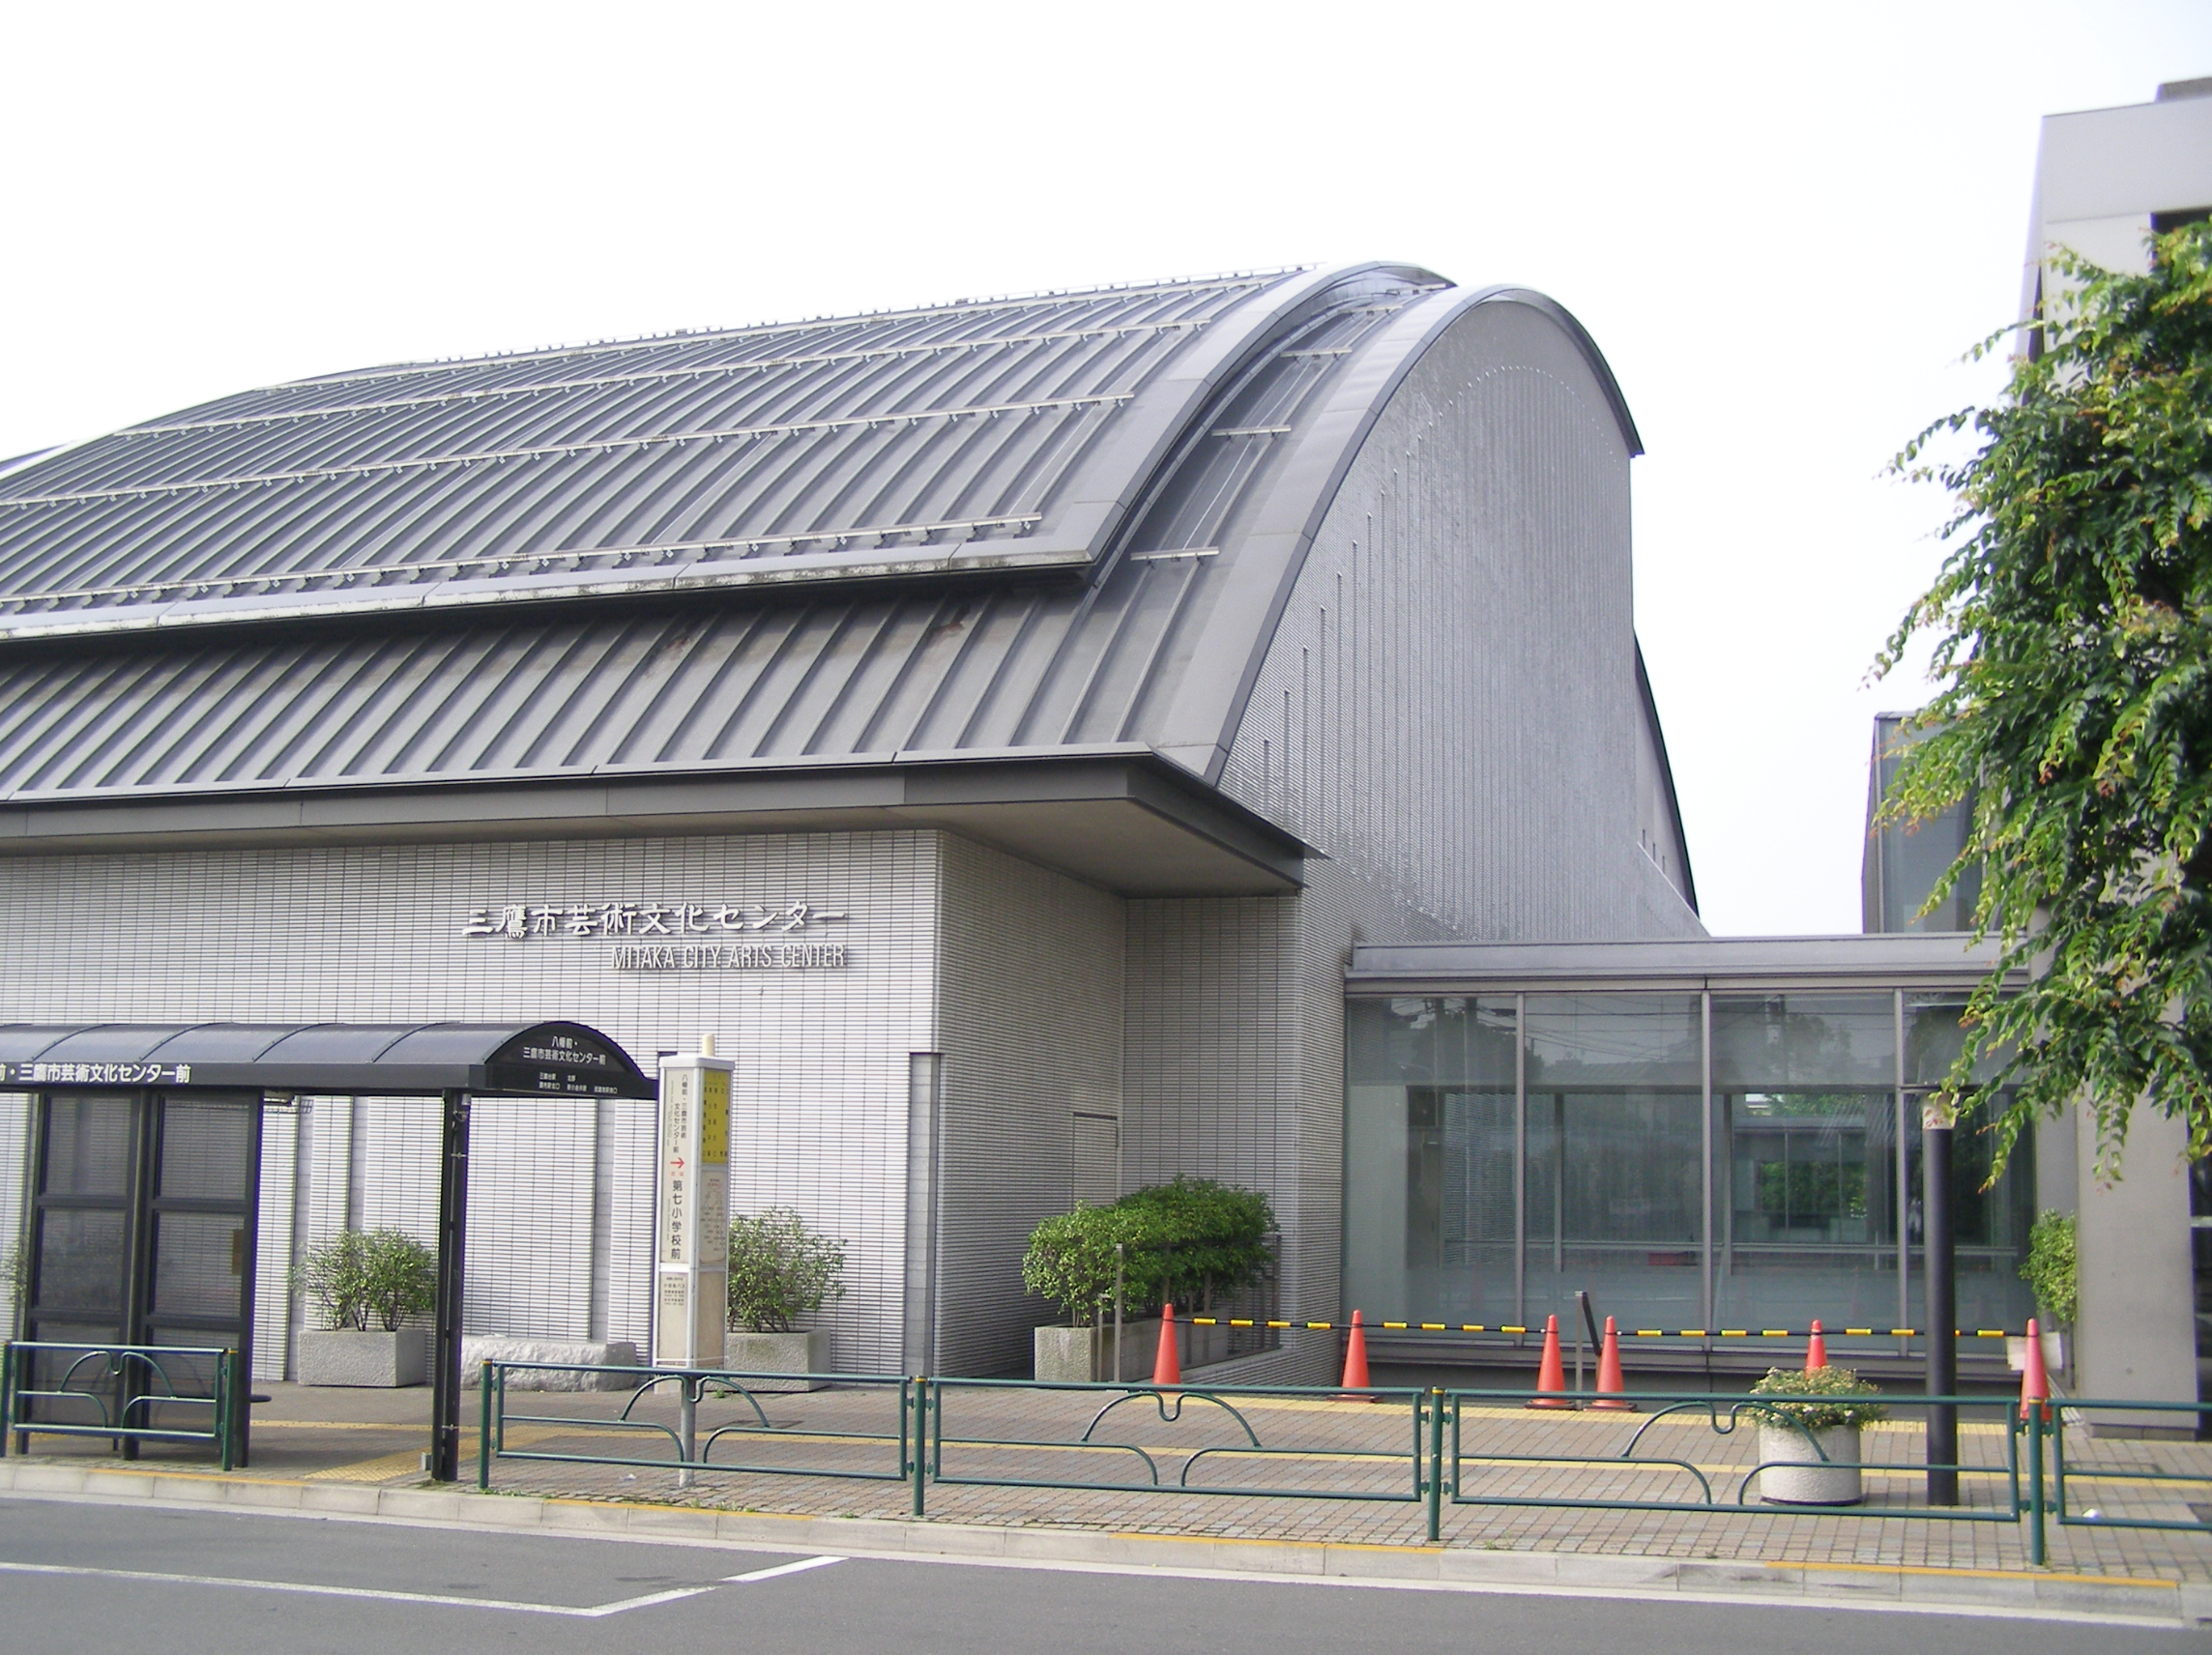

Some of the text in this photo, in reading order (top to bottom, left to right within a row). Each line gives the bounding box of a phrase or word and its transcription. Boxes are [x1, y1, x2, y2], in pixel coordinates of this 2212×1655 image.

[462, 901, 846, 939] 三鷹市芸術文化センター
[611, 944, 847, 970] MITAKA CITY ARTS CENTER
[523, 1046, 606, 1065] 三鷹市芸術文化センター前
[670, 1179, 683, 1260] 第七小学校前
